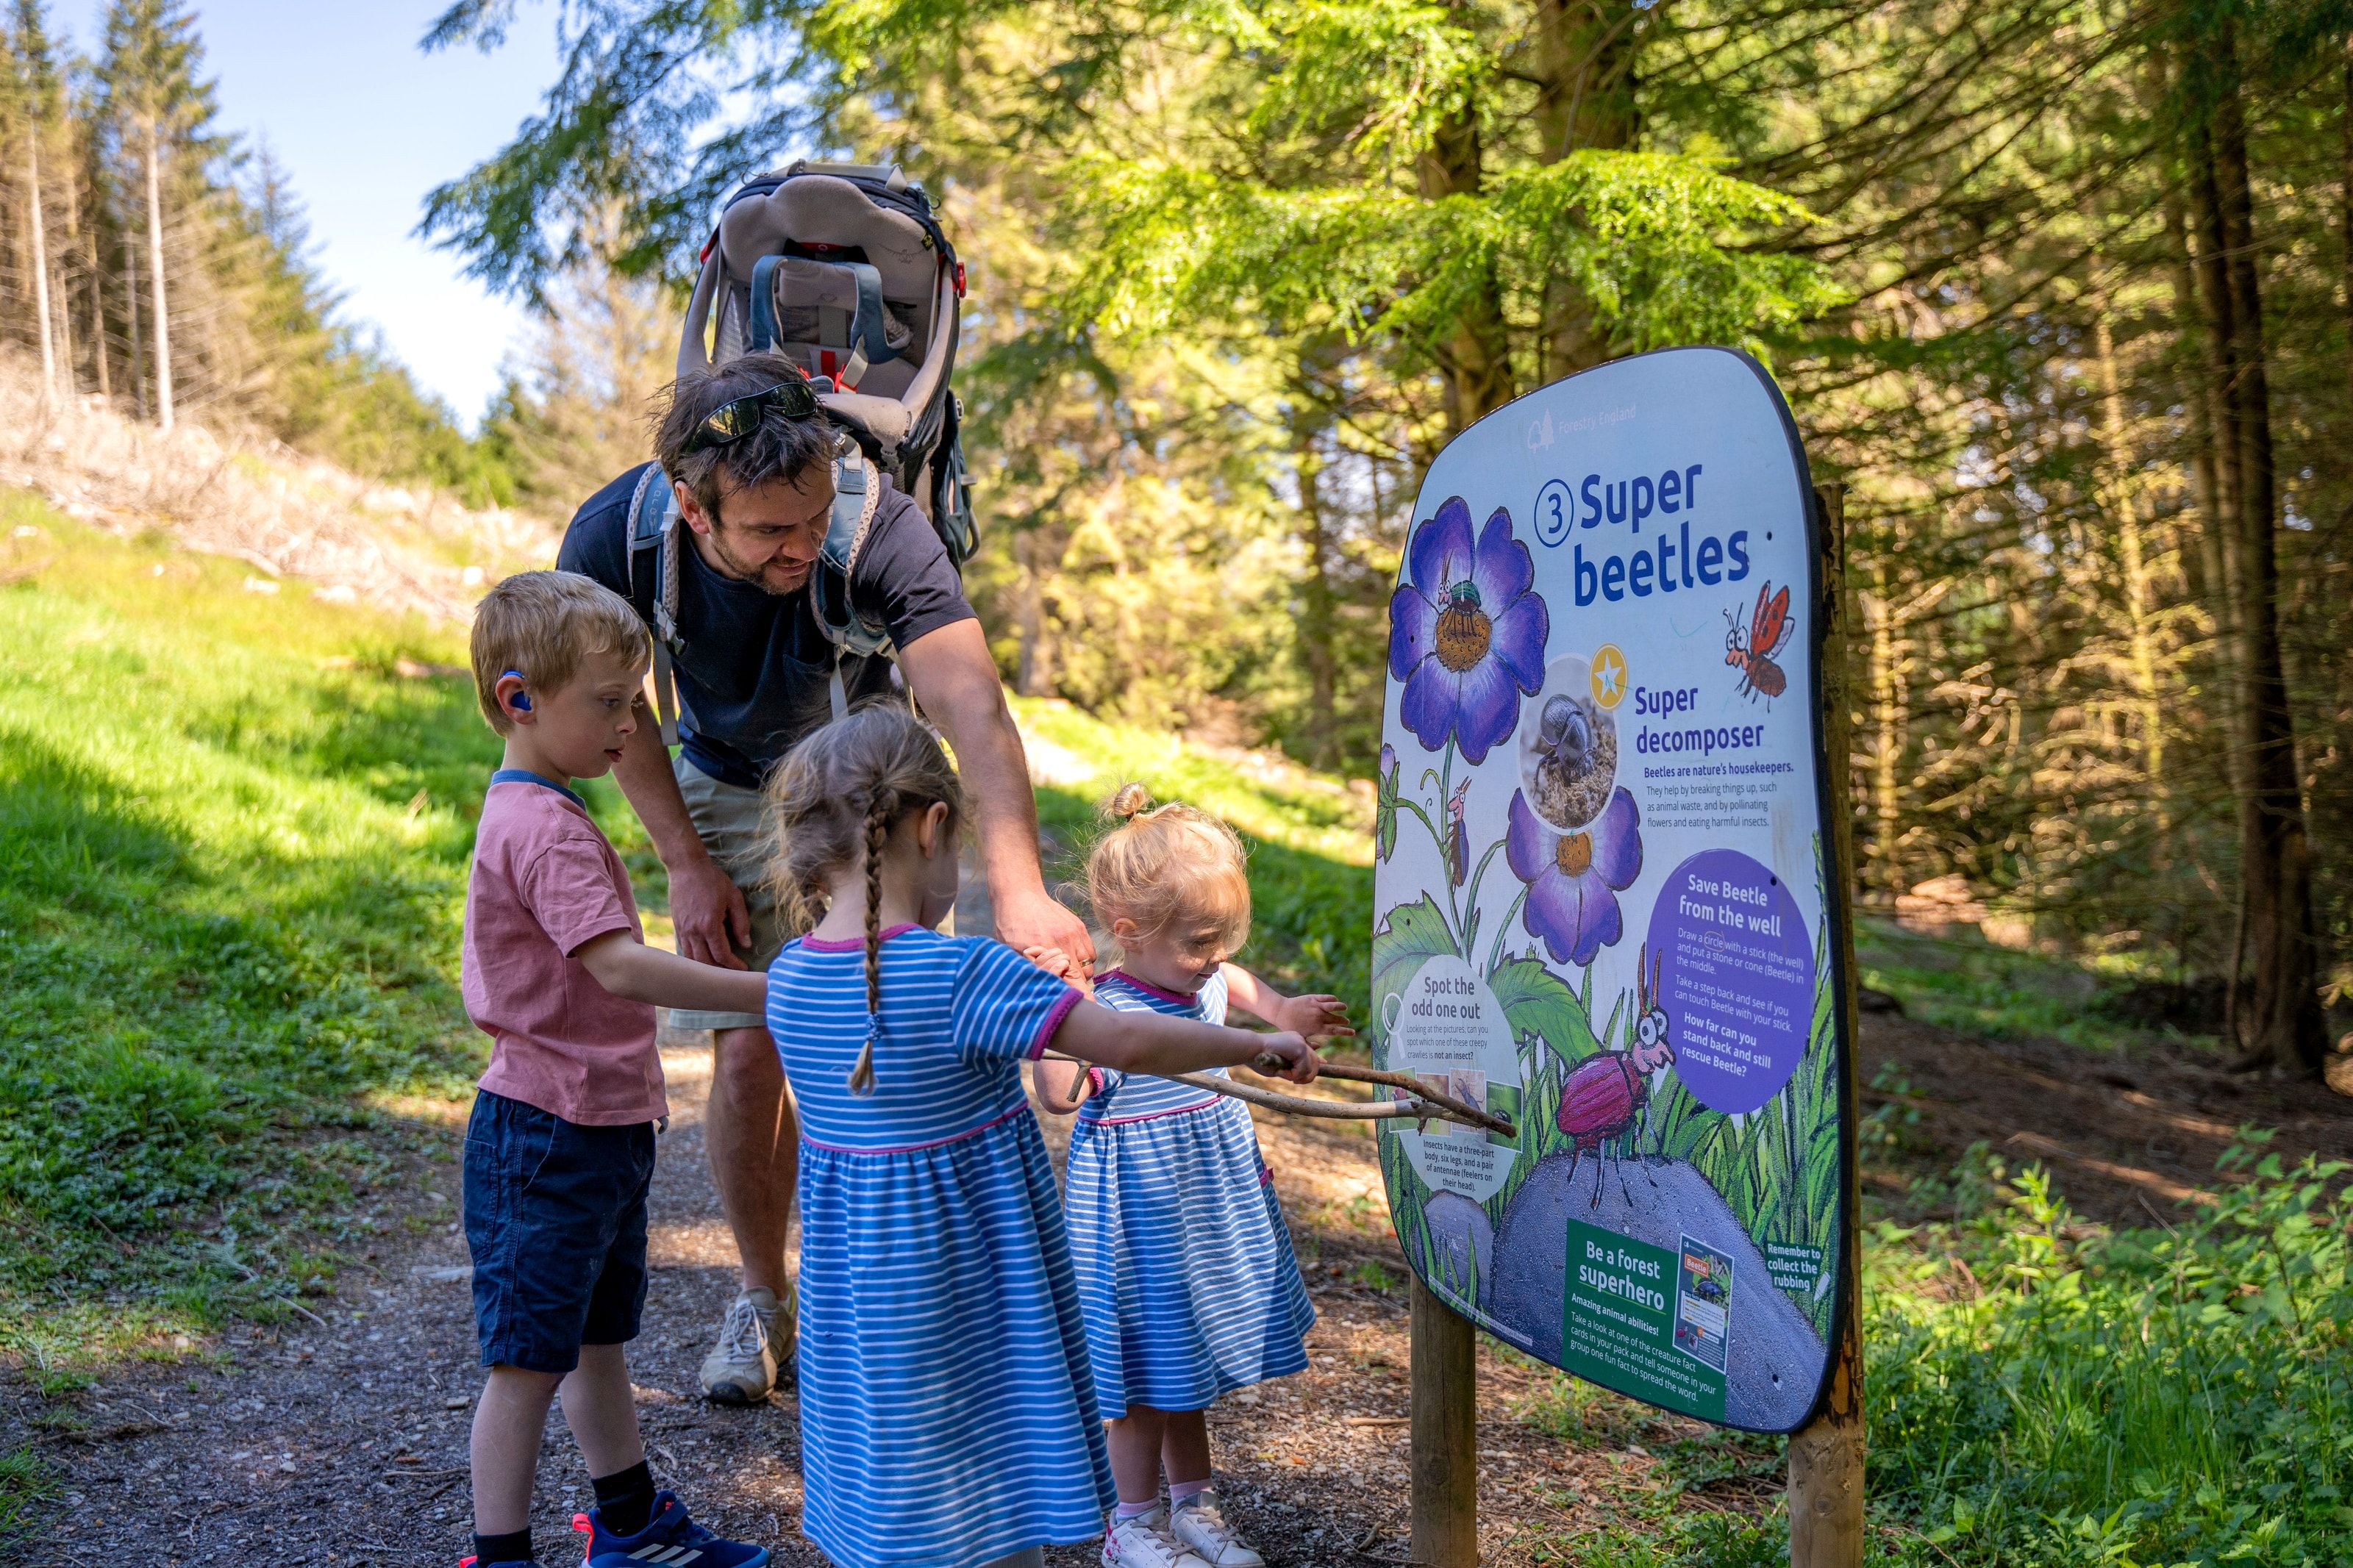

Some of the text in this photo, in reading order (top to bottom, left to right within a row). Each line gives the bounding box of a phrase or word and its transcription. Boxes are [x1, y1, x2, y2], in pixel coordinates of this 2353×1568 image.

[1559, 404, 1636, 434] Forestry England
[1548, 464, 1702, 534] 3 Super
[1574, 520, 1750, 606] beetles
[1635, 686, 1698, 720] Super
[1636, 725, 1763, 756] decomposer
[1644, 765, 1675, 778] Beetles
[1677, 767, 1690, 776] are
[1729, 761, 1793, 775] housekeepers.
[1646, 781, 1777, 797] They help by breaking things up, such
[1647, 798, 1768, 812] as animal waste, and by pollinating
[1648, 816, 1769, 829] flowers and eating harmful insects.
[1688, 874, 1767, 906] Save Beetle
[1679, 895, 1781, 937] from the well
[1677, 942, 1804, 984] and put a stone or cone (Beetle) in
[1678, 927, 1804, 971] Draw a circle with a stick (the well)
[1677, 955, 1716, 975] the middle.
[1424, 976, 1475, 998] Spot the
[1676, 974, 1789, 1016] Take a step back and see if you
[1412, 998, 1481, 1020] odd one out
[1675, 990, 1793, 1033] can touch Beetle with your stick.
[1406, 1025, 1427, 1035] Looking
[1433, 1025, 1443, 1034] the
[1443, 1025, 1466, 1035] pictures,
[1478, 1027, 1488, 1037] you
[1407, 1039, 1418, 1048] spot
[1419, 1038, 1435, 1046] which
[1446, 1039, 1453, 1047] of
[1453, 1039, 1468, 1047] these
[1469, 1040, 1488, 1050] creepy
[1684, 1012, 1757, 1047] How far can you
[1407, 1051, 1428, 1059] crawlies
[1454, 1051, 1474, 1060] insect?
[1682, 1046, 1747, 1077] rescue Beetle?
[1683, 1029, 1771, 1069] stand back and still
[1424, 1139, 1443, 1150] Insects
[1444, 1142, 1458, 1152] have
[1464, 1145, 1495, 1159] three-part
[1425, 1151, 1440, 1163] body,
[1440, 1153, 1449, 1163] six
[1450, 1155, 1463, 1167] legs,
[1464, 1158, 1475, 1167] and
[1481, 1161, 1493, 1171] pair
[1427, 1163, 1493, 1182] of antennae (feelers on
[1443, 1177, 1476, 1192] their head).
[1586, 1240, 1660, 1279] Be a forest
[1687, 1258, 1707, 1273] Beetle
[1768, 1243, 1821, 1259] Remember to
[1768, 1258, 1817, 1274] collect the
[1579, 1264, 1664, 1311] superhero
[1774, 1274, 1810, 1292] rubbing
[1571, 1292, 1601, 1314] Amazing
[1602, 1306, 1627, 1322] animal
[1628, 1314, 1659, 1336] abilities!
[1571, 1311, 1586, 1326] Take
[1588, 1318, 1592, 1328] a
[1593, 1317, 1607, 1334] look
[1608, 1325, 1615, 1338] at
[1616, 1331, 1629, 1345] one
[1630, 1334, 1638, 1347] of
[1639, 1338, 1651, 1353] the
[1652, 1344, 1682, 1365] creature
[1682, 1355, 1696, 1372] fact
[1570, 1339, 1699, 1403] group one fun fact to spread the word.
[1571, 1326, 1716, 1396] cards in your pack and tell someone in your
